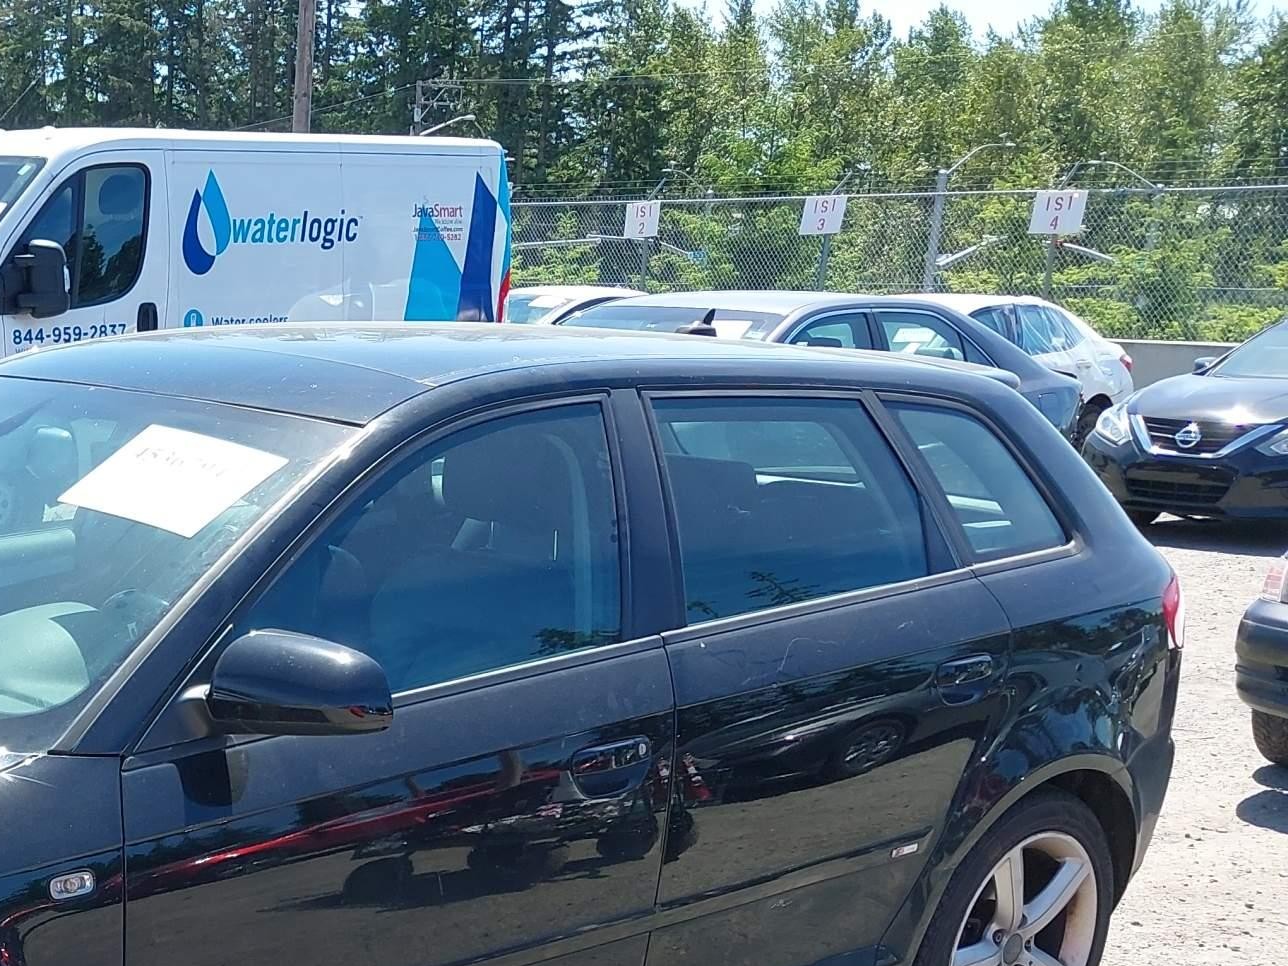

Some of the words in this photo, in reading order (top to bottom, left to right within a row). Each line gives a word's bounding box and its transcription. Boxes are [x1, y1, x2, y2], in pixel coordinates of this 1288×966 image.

[412, 204, 463, 217] JavaSmart
[232, 209, 359, 250] waterlogic
[638, 222, 645, 234] 2
[817, 218, 825, 231] 3
[1050, 215, 1059, 230] 4
[12, 323, 127, 345] 844-959-2837
